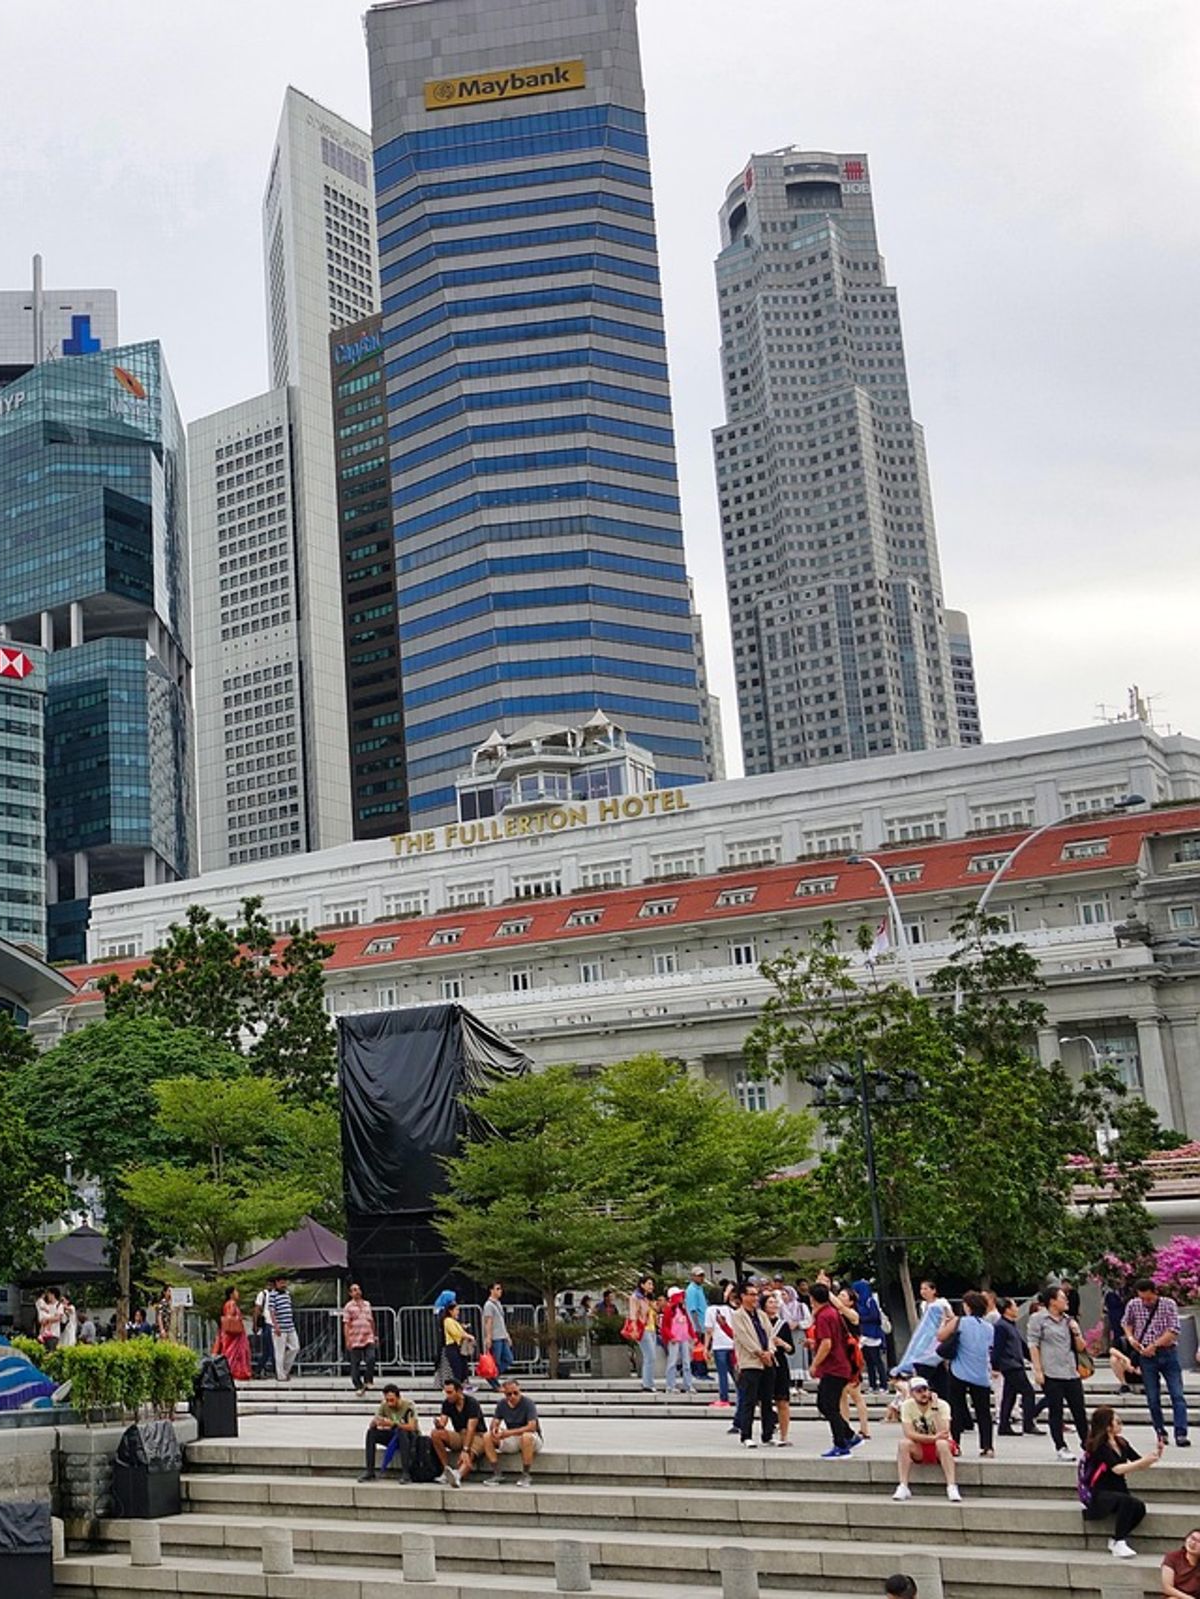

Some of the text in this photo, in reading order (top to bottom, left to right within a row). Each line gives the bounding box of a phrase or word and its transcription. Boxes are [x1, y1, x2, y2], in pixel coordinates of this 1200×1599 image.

[458, 66, 570, 96] Maybank
[841, 183, 871, 194] UOB
[390, 789, 690, 855] THE FULLERTON HOTEL
